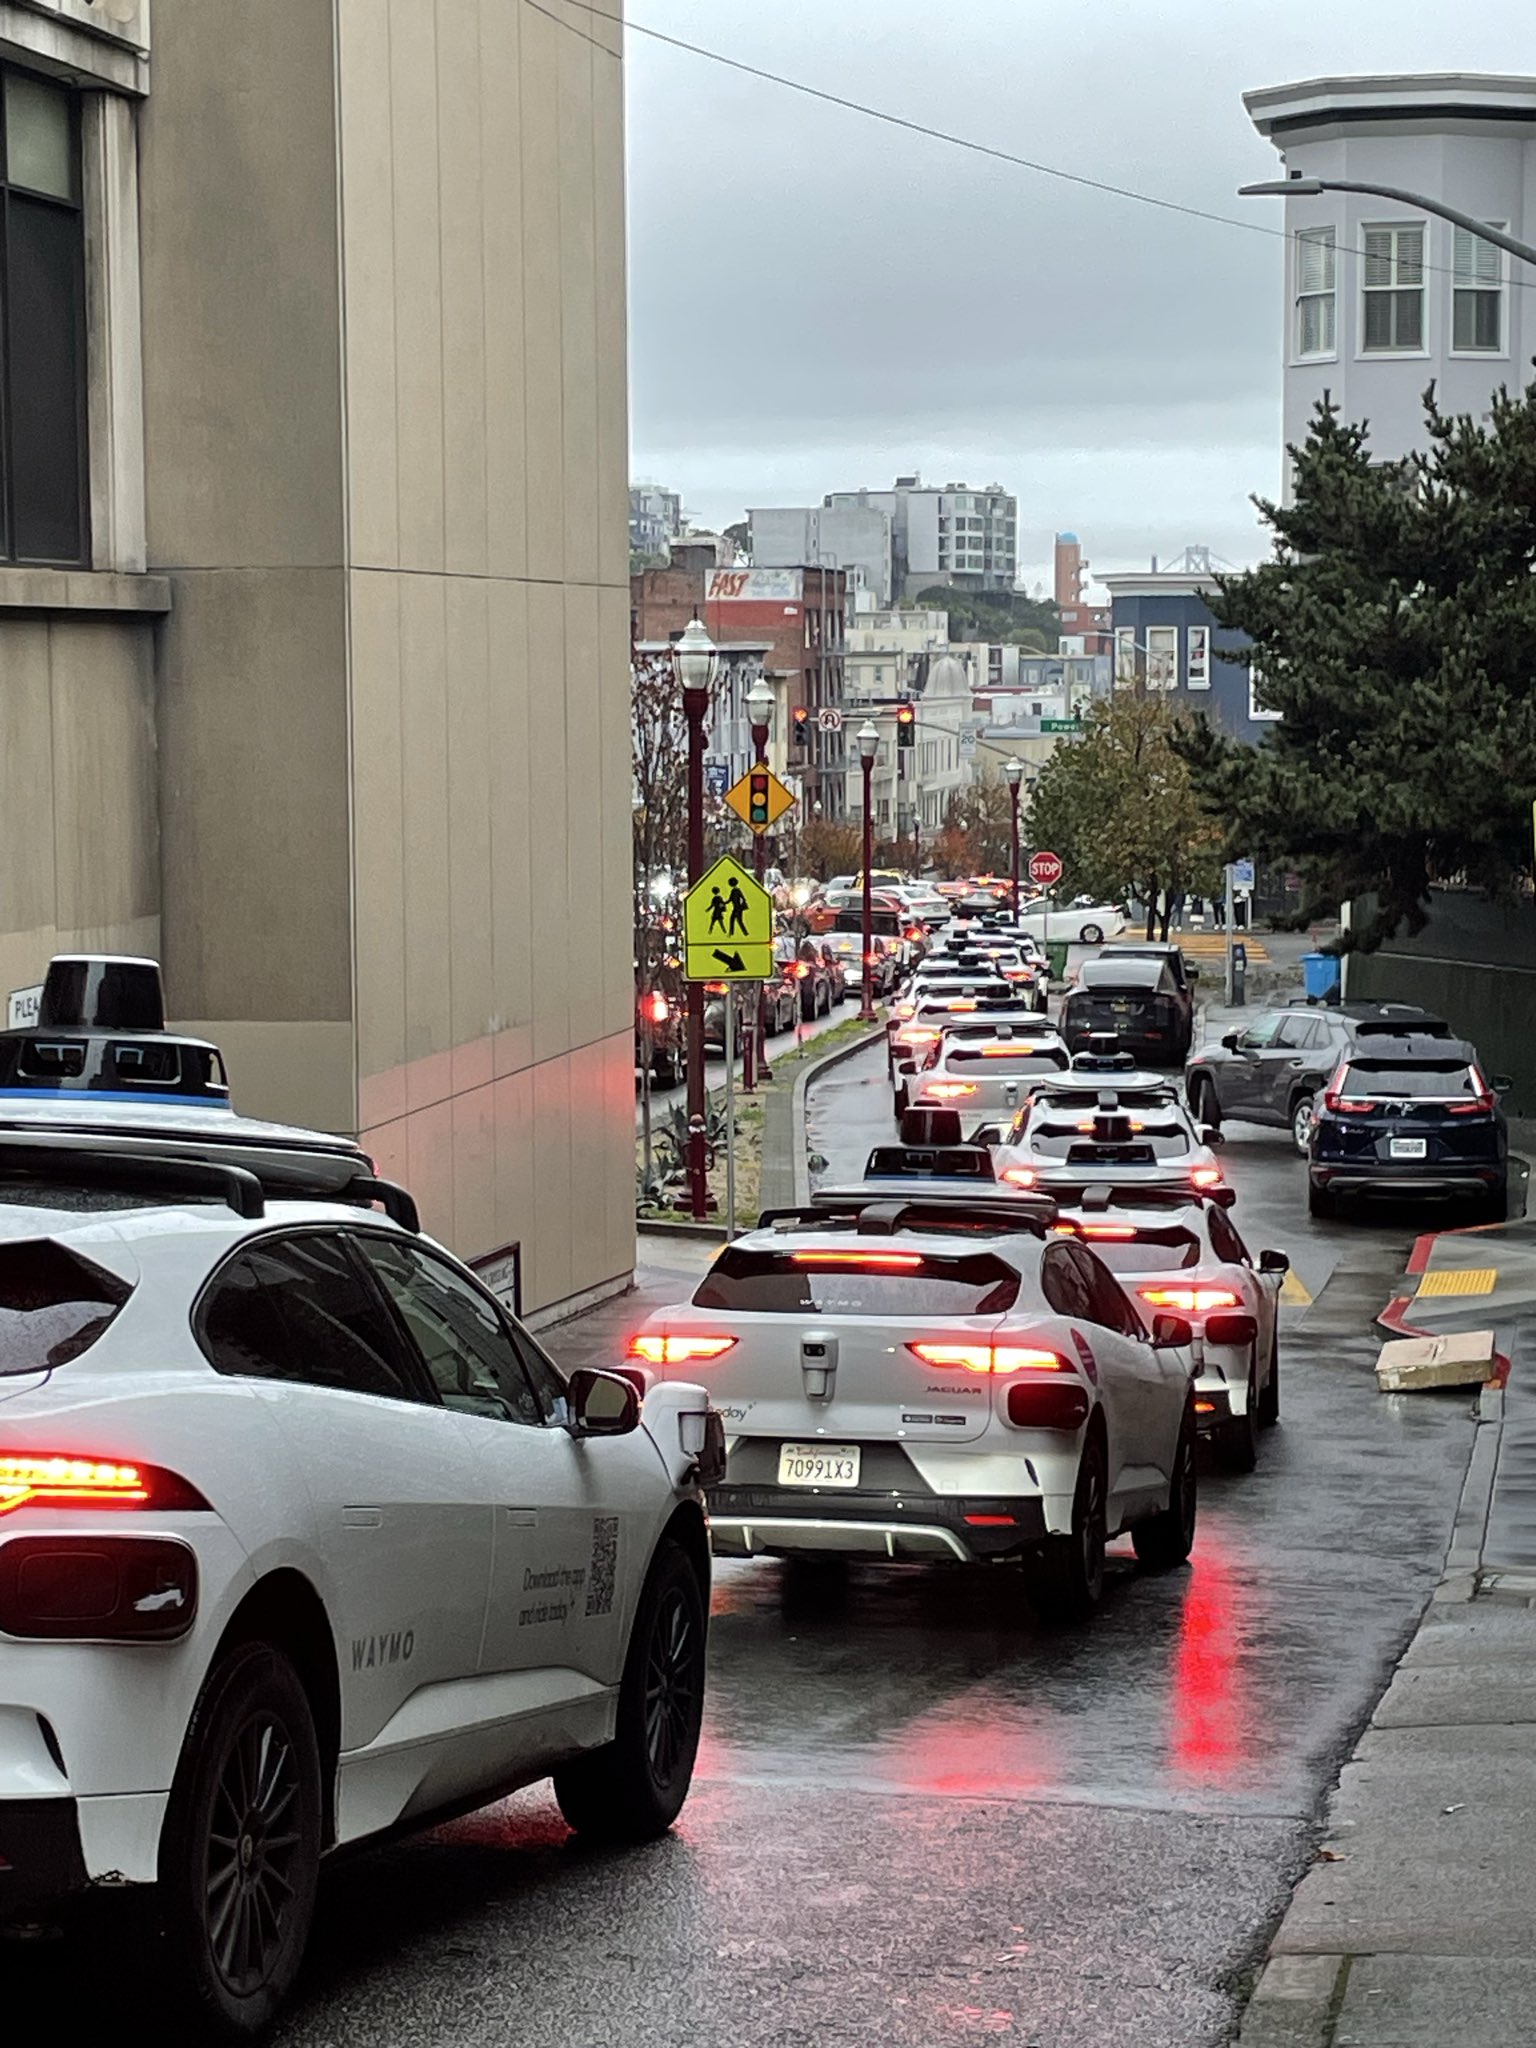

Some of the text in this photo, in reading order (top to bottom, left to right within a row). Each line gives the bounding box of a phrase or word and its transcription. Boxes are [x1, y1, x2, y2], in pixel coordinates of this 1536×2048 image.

[1031, 862, 1060, 876] STOP
[800, 1299, 863, 1307] WAYMO
[924, 1386, 982, 1395] JAGUAR
[785, 1459, 854, 1479] 70991X3
[352, 1629, 414, 1671] WAYMO
